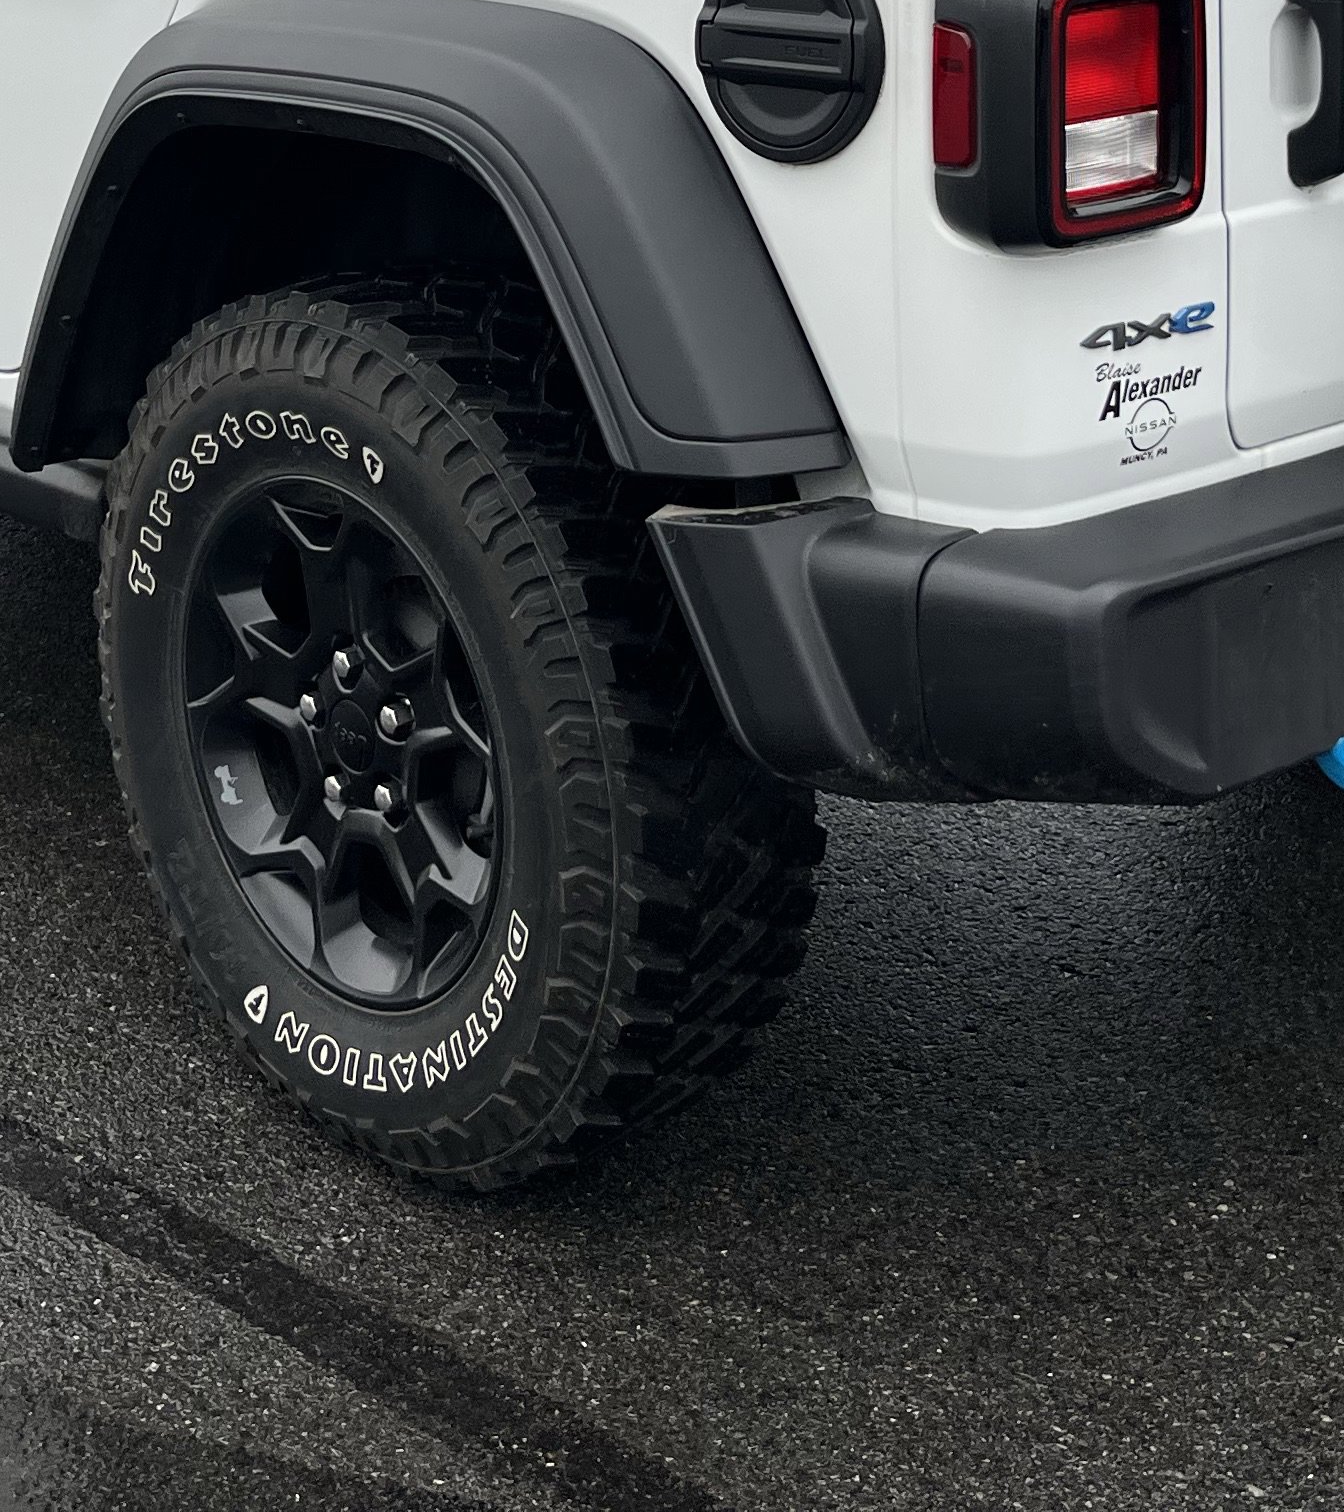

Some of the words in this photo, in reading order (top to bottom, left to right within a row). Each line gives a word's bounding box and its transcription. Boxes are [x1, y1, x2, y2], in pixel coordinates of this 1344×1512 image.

[1095, 362, 1141, 383] Blaise
[1099, 366, 1202, 421] Alexander
[1125, 414, 1177, 436] NISSAN
[1157, 447, 1168, 458] PA
[129, 411, 349, 595] Firestone
[274, 910, 528, 1092] DESTINATION
